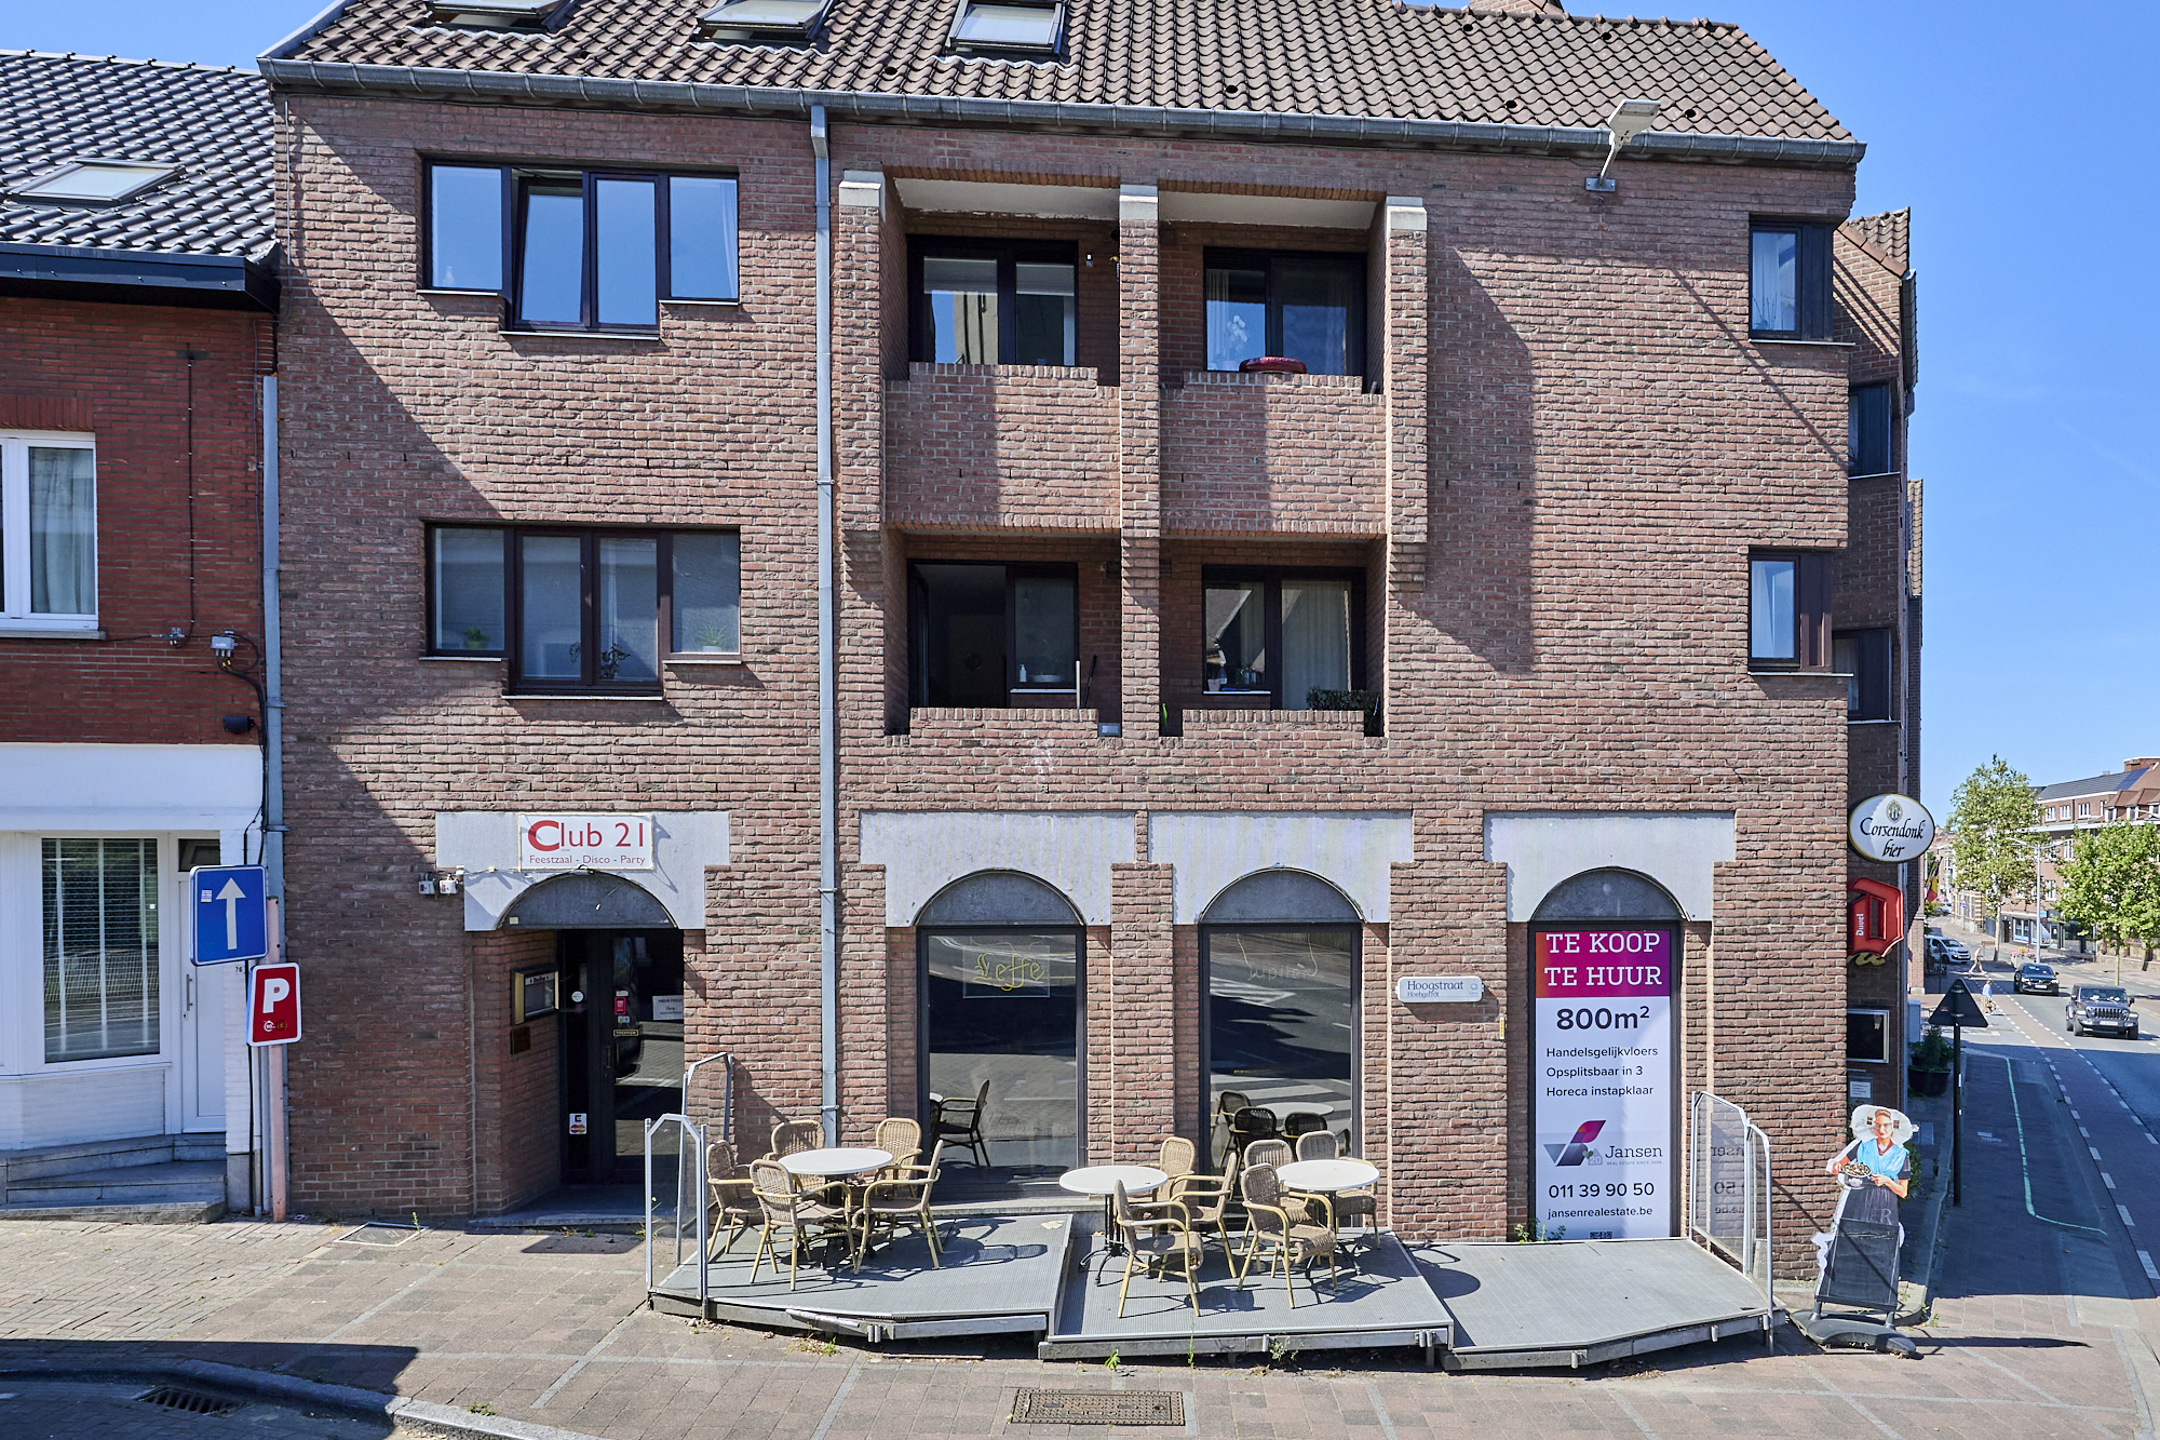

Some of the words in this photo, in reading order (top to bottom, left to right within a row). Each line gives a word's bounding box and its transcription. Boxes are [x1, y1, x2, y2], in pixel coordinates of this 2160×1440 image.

[527, 819, 603, 852] Club
[615, 822, 644, 847] 21
[1860, 817, 1926, 839] Corsendonk
[1882, 839, 1905, 857] bier
[529, 855, 573, 864] Feestzaal
[582, 855, 610, 864] Disco
[620, 855, 646, 866] Party
[1546, 933, 1580, 953] TE
[1589, 932, 1661, 953] KOOP
[973, 952, 1045, 992] Leffe
[1544, 967, 1578, 986] TE
[1586, 966, 1663, 986] HUUR
[1407, 981, 1464, 993] Hoogstraat
[263, 978, 290, 1013] P
[1546, 1046, 1659, 1059] Handelsgelijkvloers
[1546, 1066, 1619, 1079] Opsplitsbaar
[1622, 1065, 1633, 1076] in
[1635, 1065, 1644, 1076] 3
[1546, 1087, 1588, 1097] Horeca
[1591, 1085, 1654, 1098] instapklaar
[1605, 1145, 1663, 1158] Jansen
[1548, 1184, 1574, 1198] 011
[1579, 1183, 1600, 1198] 39
[1605, 1183, 1628, 1197] 90
[1633, 1182, 1655, 1196] 50
[1547, 1206, 1653, 1220] jansenrealestate.be
